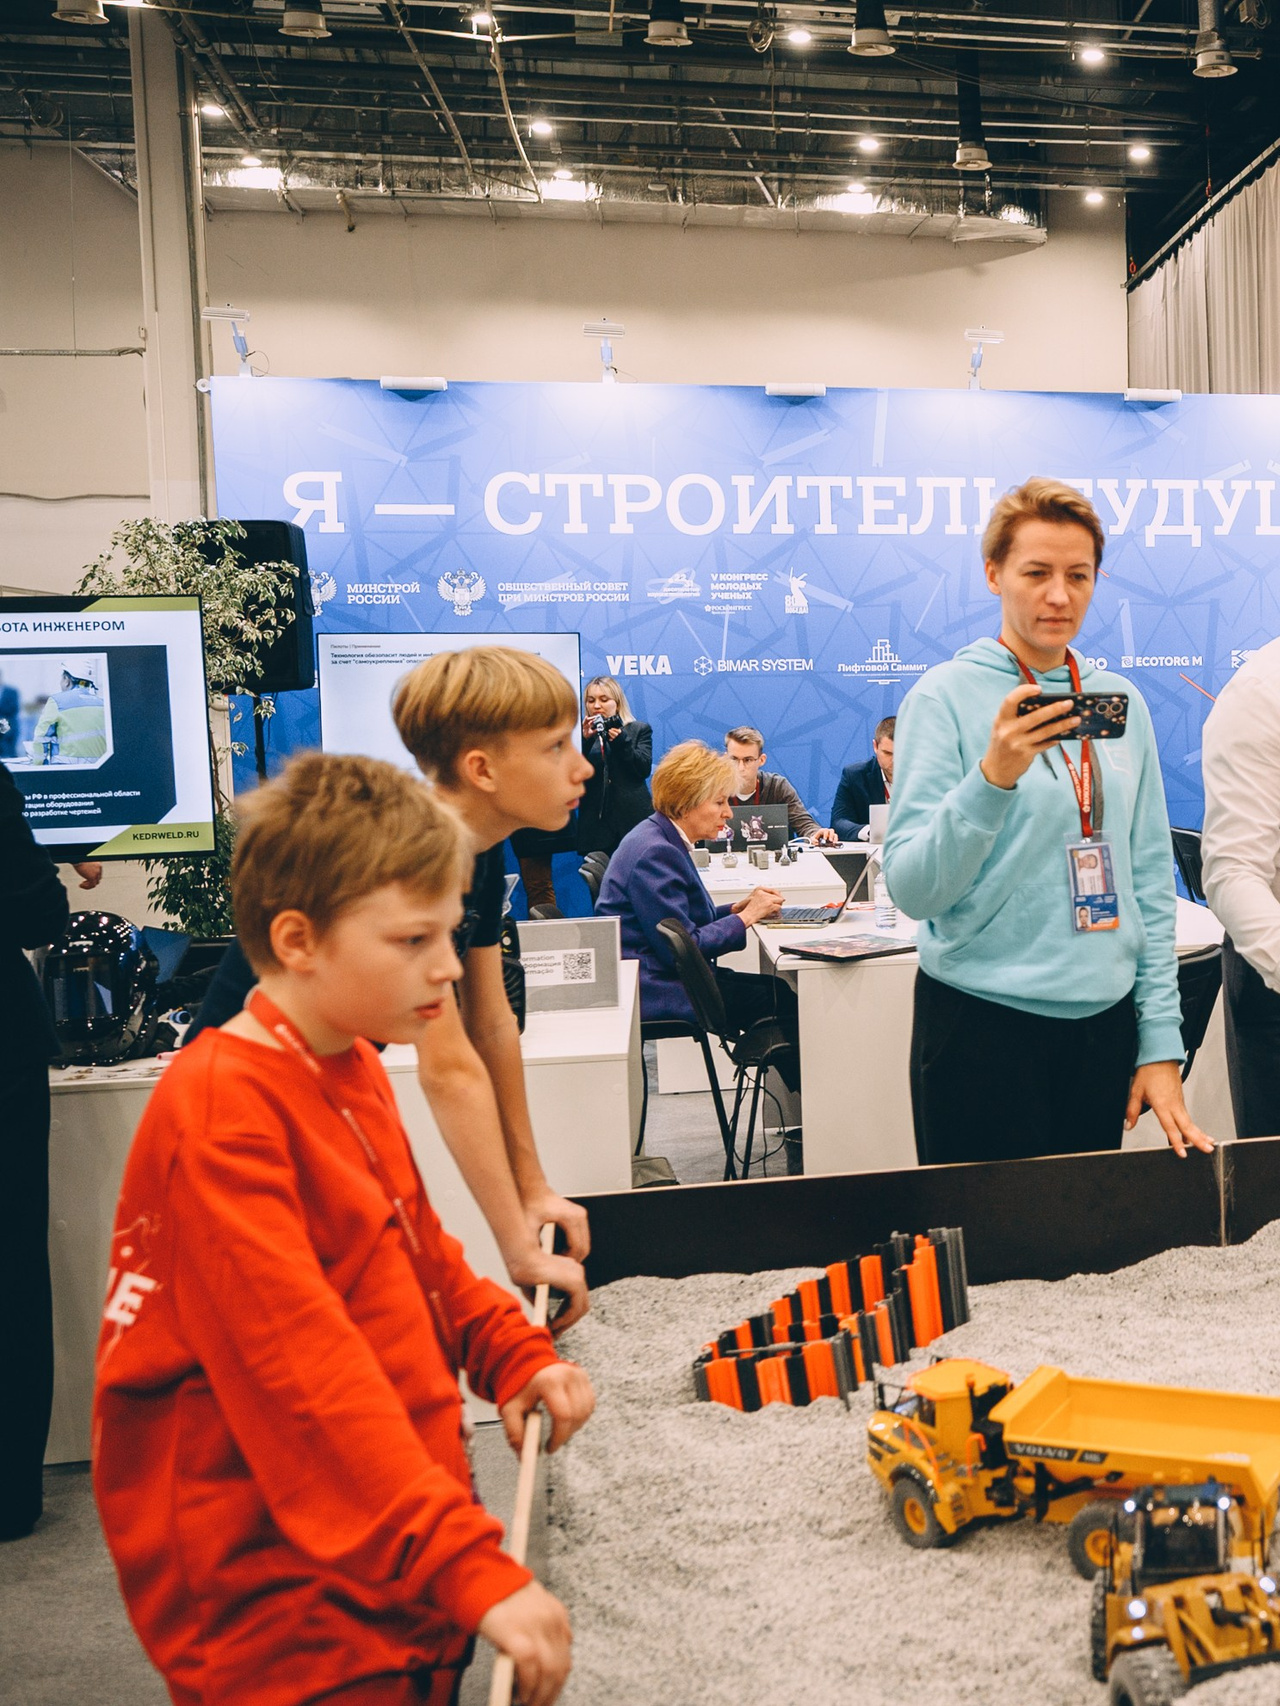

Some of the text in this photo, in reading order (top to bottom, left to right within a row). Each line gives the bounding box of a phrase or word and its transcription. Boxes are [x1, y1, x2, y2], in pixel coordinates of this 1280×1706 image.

[283, 471, 345, 533] Я
[711, 573, 769, 581] V КОНГРЕСС
[347, 582, 420, 594] МИНСТРОЙ
[497, 580, 628, 591] ОБЩЕСТВЕННЫЙ СОВЕТ
[711, 583, 762, 591] МОЛОДЫХ
[347, 595, 400, 604] РОССИИ
[498, 592, 629, 602] ПРИ МИНСТРОЕ РОССИИ
[711, 592, 752, 600] УЧЕНЫХ
[0, 620, 125, 633] ОТА ИНЖЕНЕРОМ
[606, 655, 672, 676] VEKA
[717, 659, 813, 672] BIMAR SYSTEM
[1136, 656, 1203, 667] ECOTORG M
[838, 663, 927, 673] Лифтовой Саммит
[49, 791, 113, 801] профессиональной
[46, 801, 94, 809] оборудования
[30, 810, 68, 818] разработке
[69, 808, 102, 816] чертежей
[133, 831, 199, 841] KEDRWELD.RU
[104, 1267, 158, 1326] E
